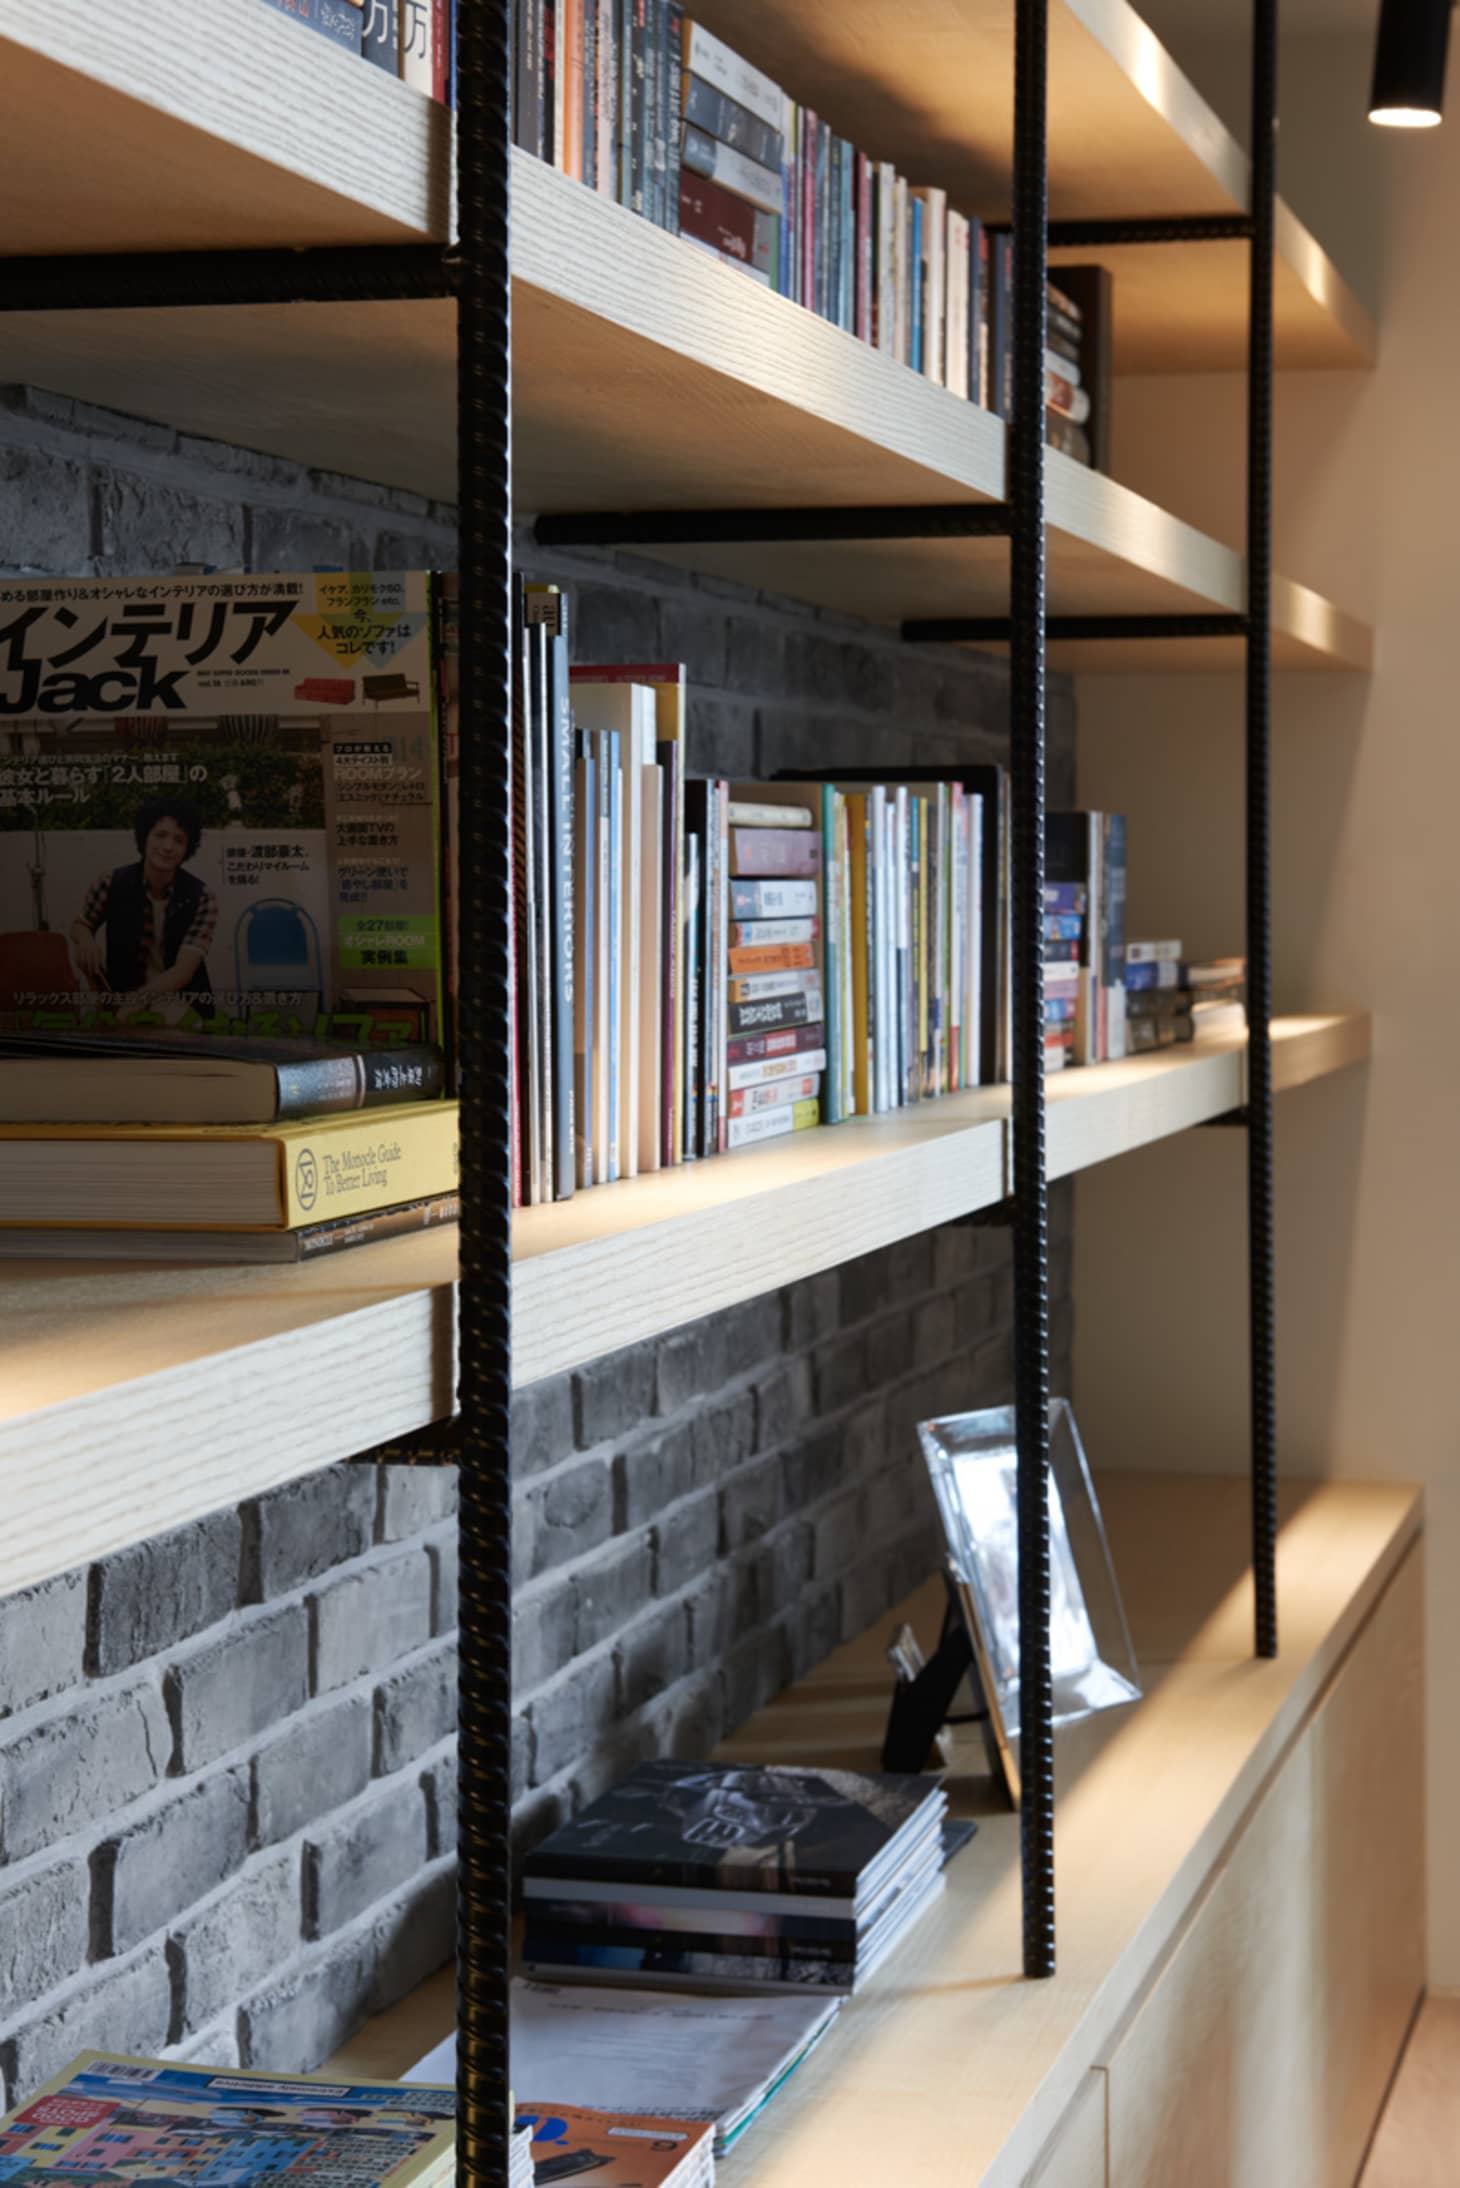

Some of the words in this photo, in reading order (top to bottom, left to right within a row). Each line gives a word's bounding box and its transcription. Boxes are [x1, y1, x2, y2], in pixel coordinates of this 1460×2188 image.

[0, 600, 298, 669] インテリア
[317, 624, 411, 640] 人気のソファは
[336, 641, 395, 655] コレです!
[0, 657, 188, 713] Jack
[560, 696, 573, 811] SMALL
[562, 821, 576, 1003] INTERIORS
[321, 1155, 339, 1176] The
[342, 1148, 377, 1171] Monocle
[377, 1142, 401, 1162] Guide
[323, 1175, 335, 1196] To
[336, 1171, 362, 1193] Better
[362, 1165, 388, 1188] Living
